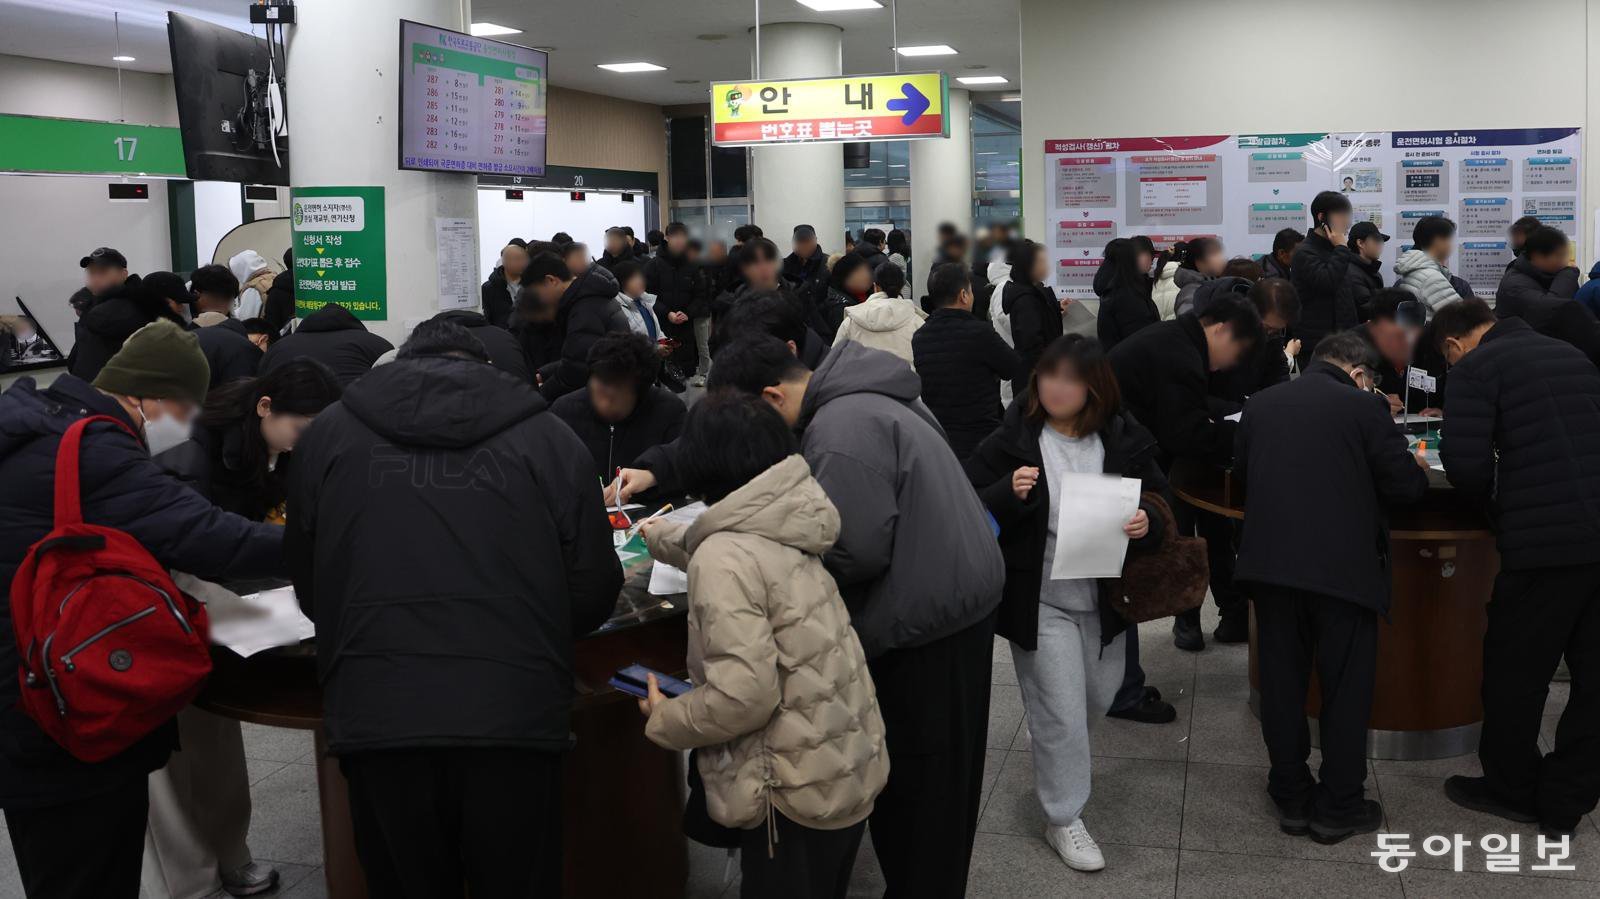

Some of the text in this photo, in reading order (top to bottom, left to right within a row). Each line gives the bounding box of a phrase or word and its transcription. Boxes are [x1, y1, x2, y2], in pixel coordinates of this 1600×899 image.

[427, 75, 439, 84] 287
[427, 88, 438, 97] 286
[494, 86, 504, 95] 281
[494, 98, 504, 107] 280
[759, 83, 873, 114] 안 내
[427, 101, 438, 110] 285
[427, 114, 438, 123] 284
[494, 111, 504, 119] 279
[494, 122, 504, 131] 278
[761, 120, 873, 140] 번호표 뽑는곳
[427, 127, 438, 136] 283
[494, 134, 504, 142] 277
[1396, 135, 1477, 146] 운전면허시험 응시절차
[426, 140, 437, 149] 282
[1054, 142, 1104, 151] 적성검사(갱신)
[1365, 139, 1381, 148] 종류
[113, 136, 138, 161] 17
[494, 147, 504, 155] 276
[417, 158, 439, 167] 인쇄되어
[440, 160, 465, 169] 국문면허증
[466, 161, 477, 169] 대비
[574, 175, 584, 187] 20
[303, 204, 321, 213] 운전면허
[330, 214, 356, 223] 연기신청
[303, 235, 342, 245] 신청서 작성
[319, 257, 333, 268] 뽑은
[335, 258, 343, 268] 후
[344, 257, 361, 268] 접수
[324, 280, 339, 290] 당일
[340, 280, 357, 291] 발급
[353, 301, 381, 311] 있습니다.
[368, 443, 506, 490] FILA
